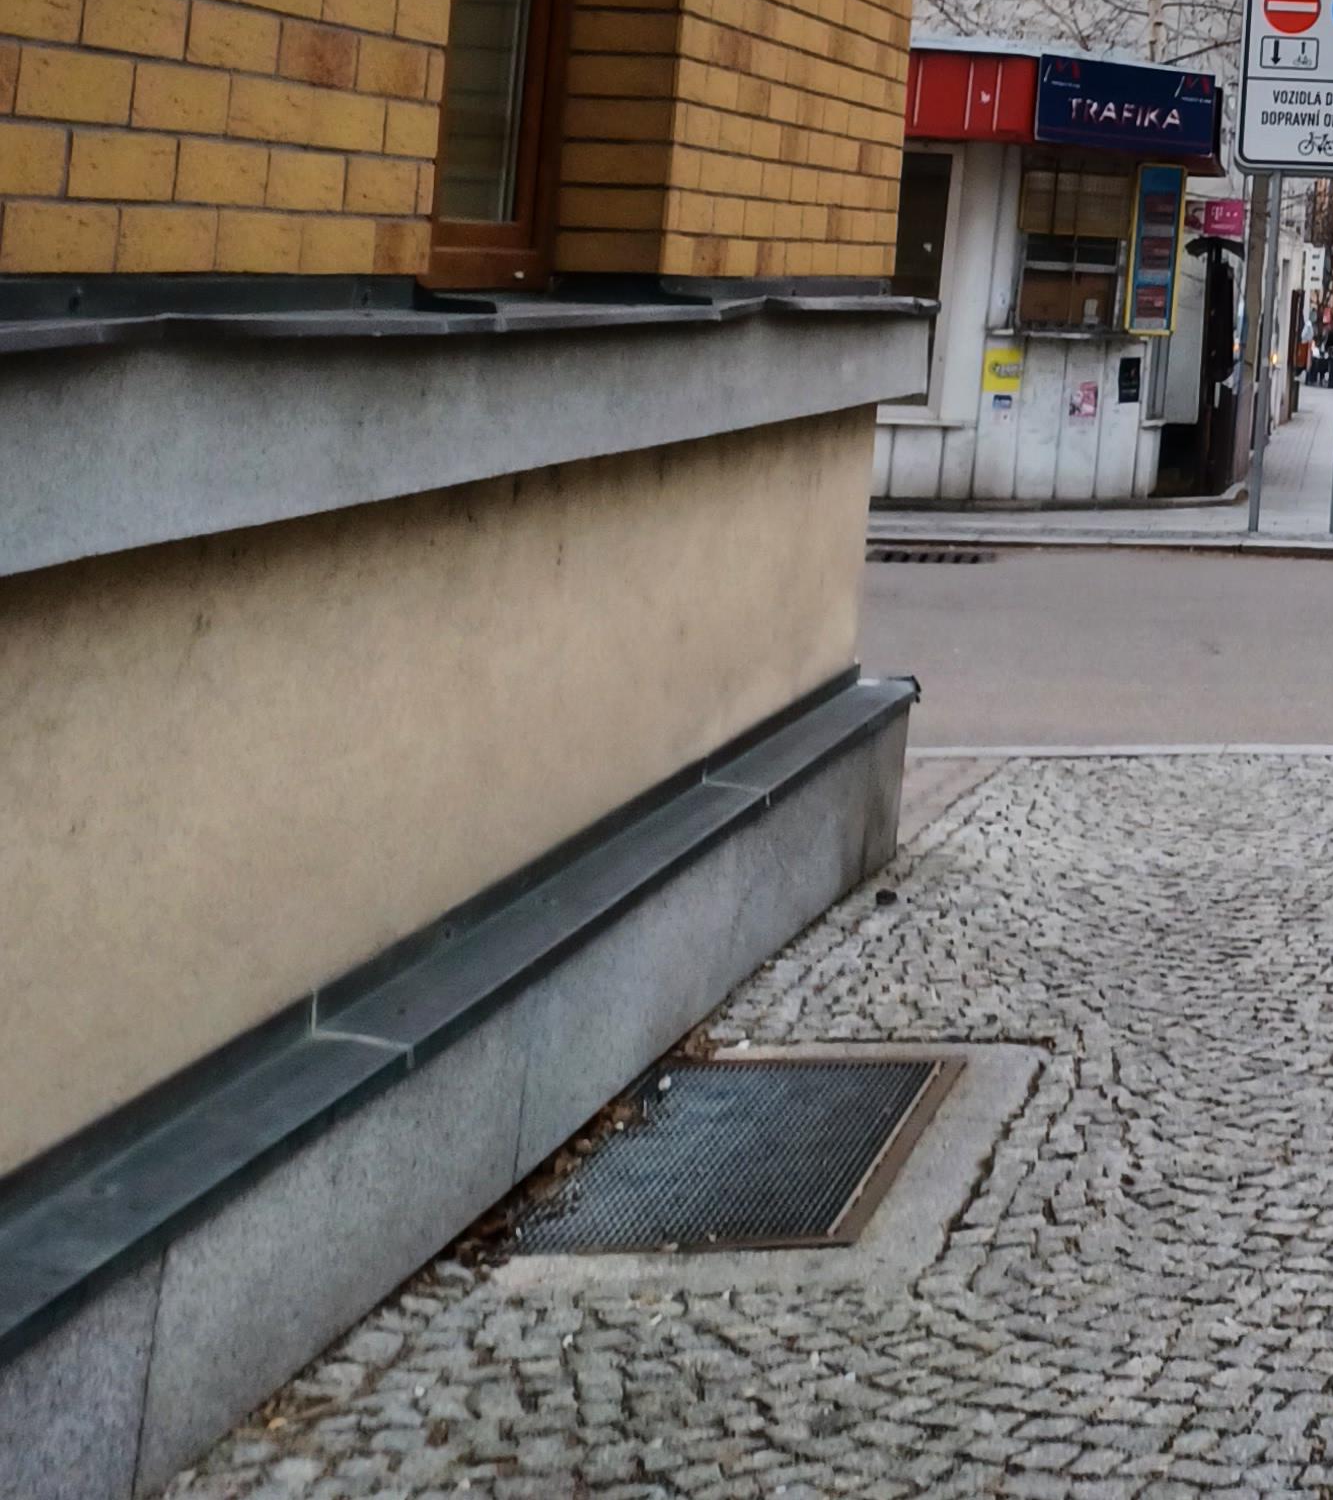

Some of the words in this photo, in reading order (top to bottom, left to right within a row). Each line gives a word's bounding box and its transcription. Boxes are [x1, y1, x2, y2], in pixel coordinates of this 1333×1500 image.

[1273, 90, 1322, 107] VOZIDLA
[1069, 97, 1183, 131] TRAFIKA
[1261, 109, 1320, 127] DOPRAVNÍ
